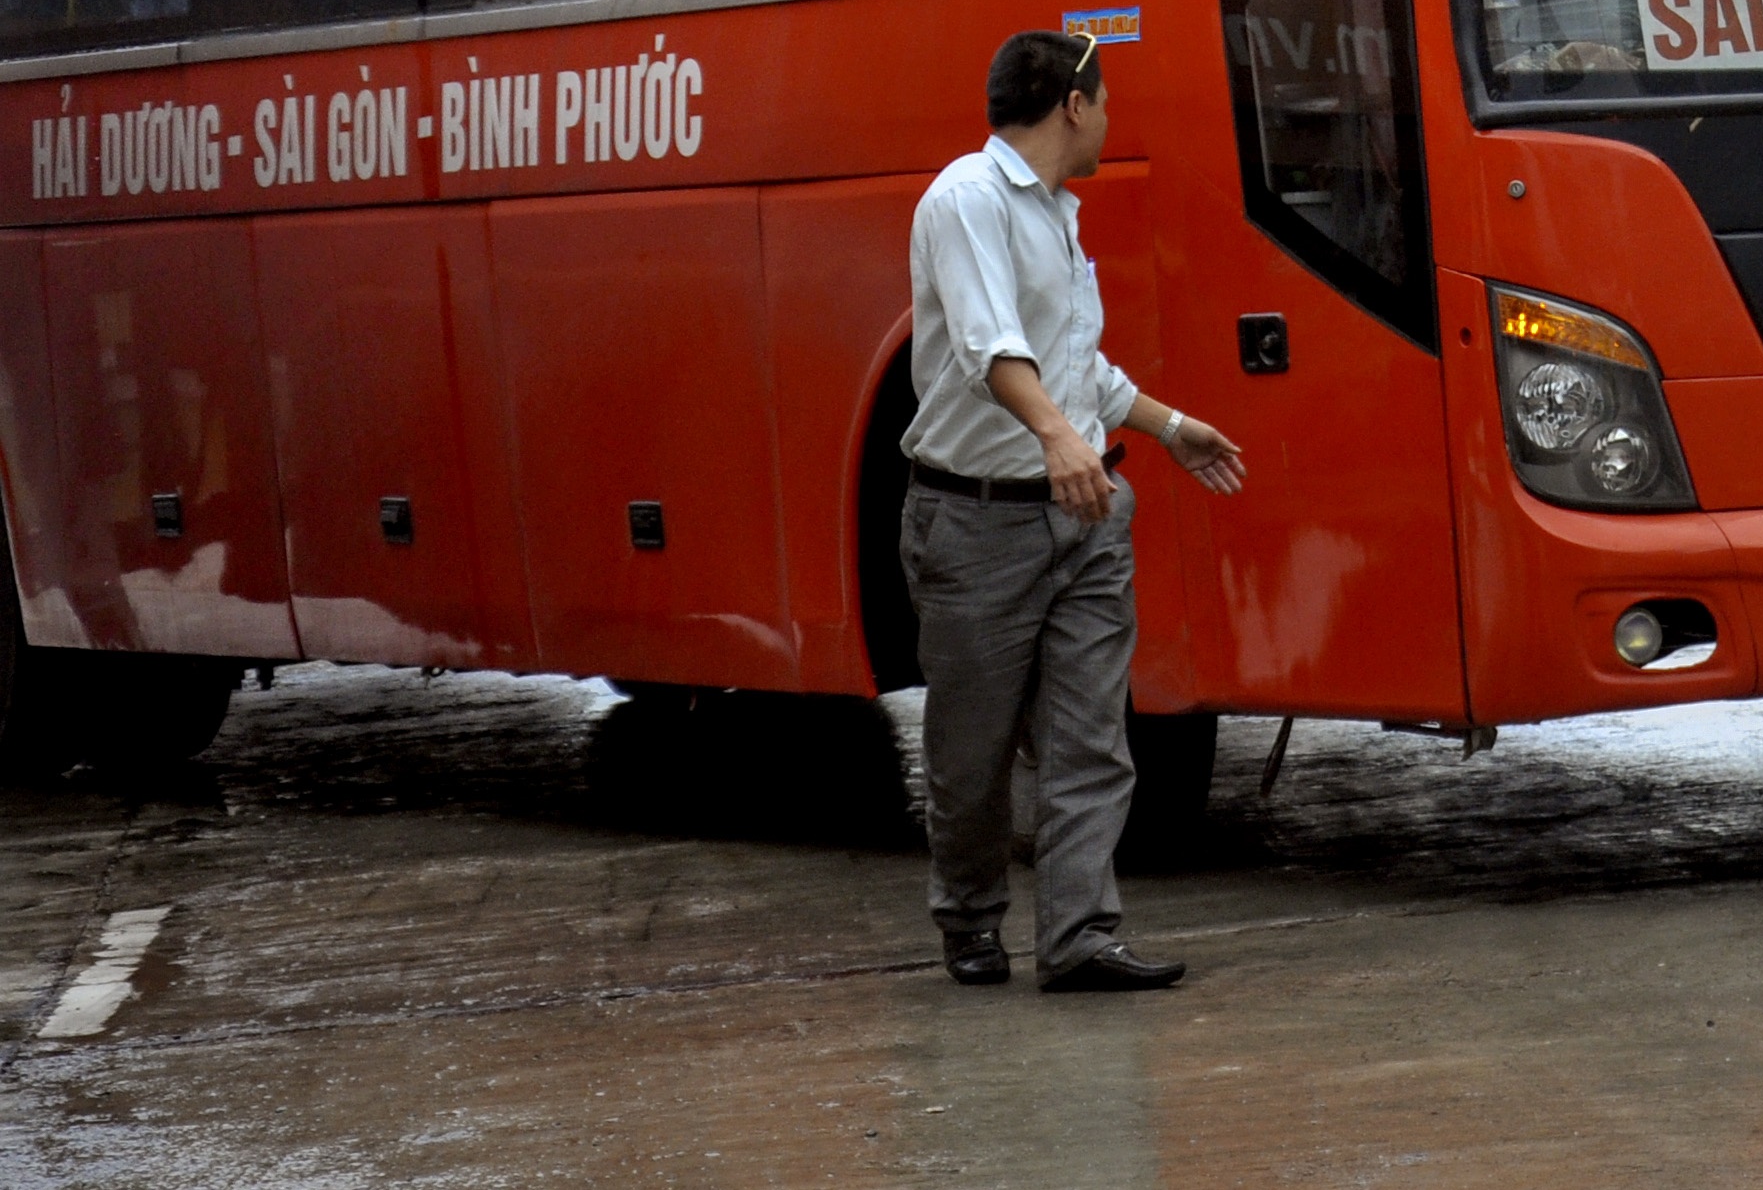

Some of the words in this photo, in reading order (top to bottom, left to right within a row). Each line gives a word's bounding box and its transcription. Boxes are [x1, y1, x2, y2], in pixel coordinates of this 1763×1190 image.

[32, 83, 87, 199] HẢI
[253, 74, 315, 189] SÀI
[328, 65, 408, 181] GÒN
[555, 34, 704, 167] PHƯỚC
